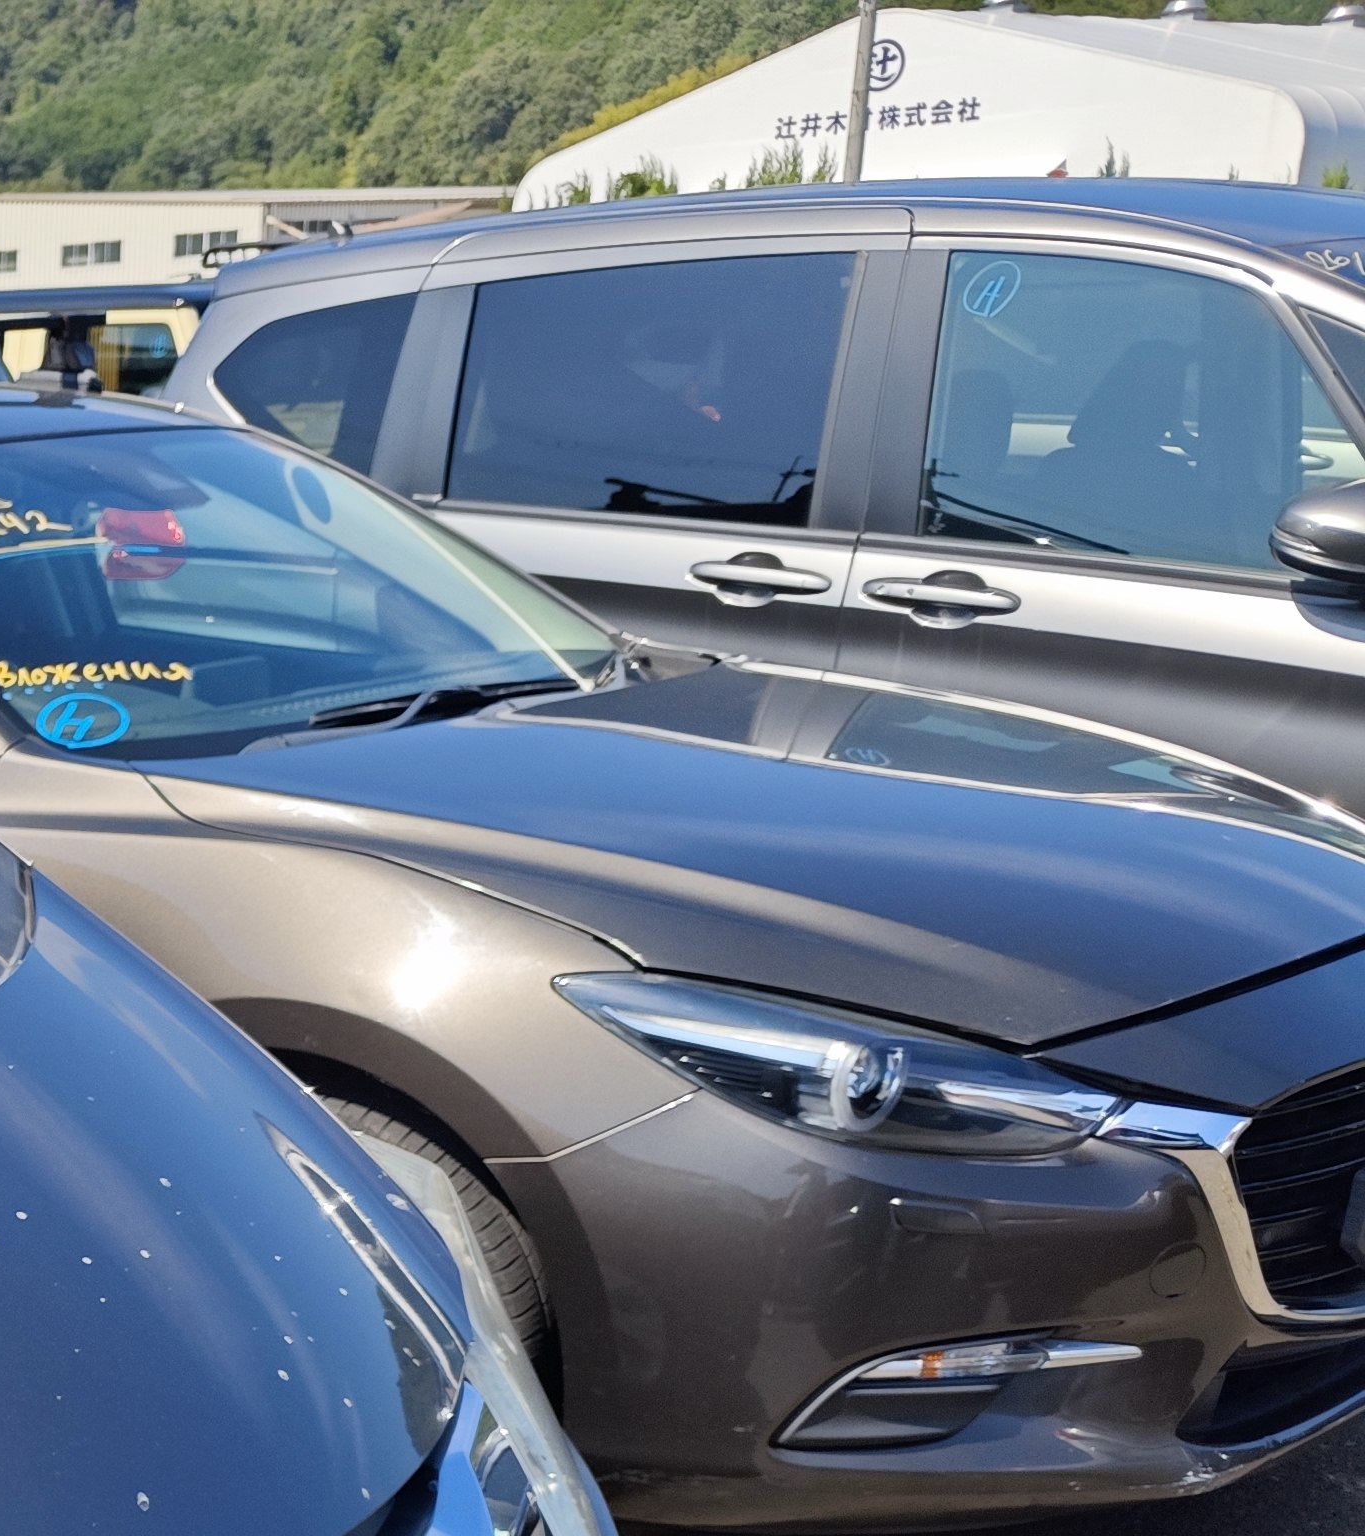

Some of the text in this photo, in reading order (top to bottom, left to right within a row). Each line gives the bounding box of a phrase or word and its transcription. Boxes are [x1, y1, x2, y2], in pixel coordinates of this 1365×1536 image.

[774, 96, 981, 139] 辻井木株式会社
